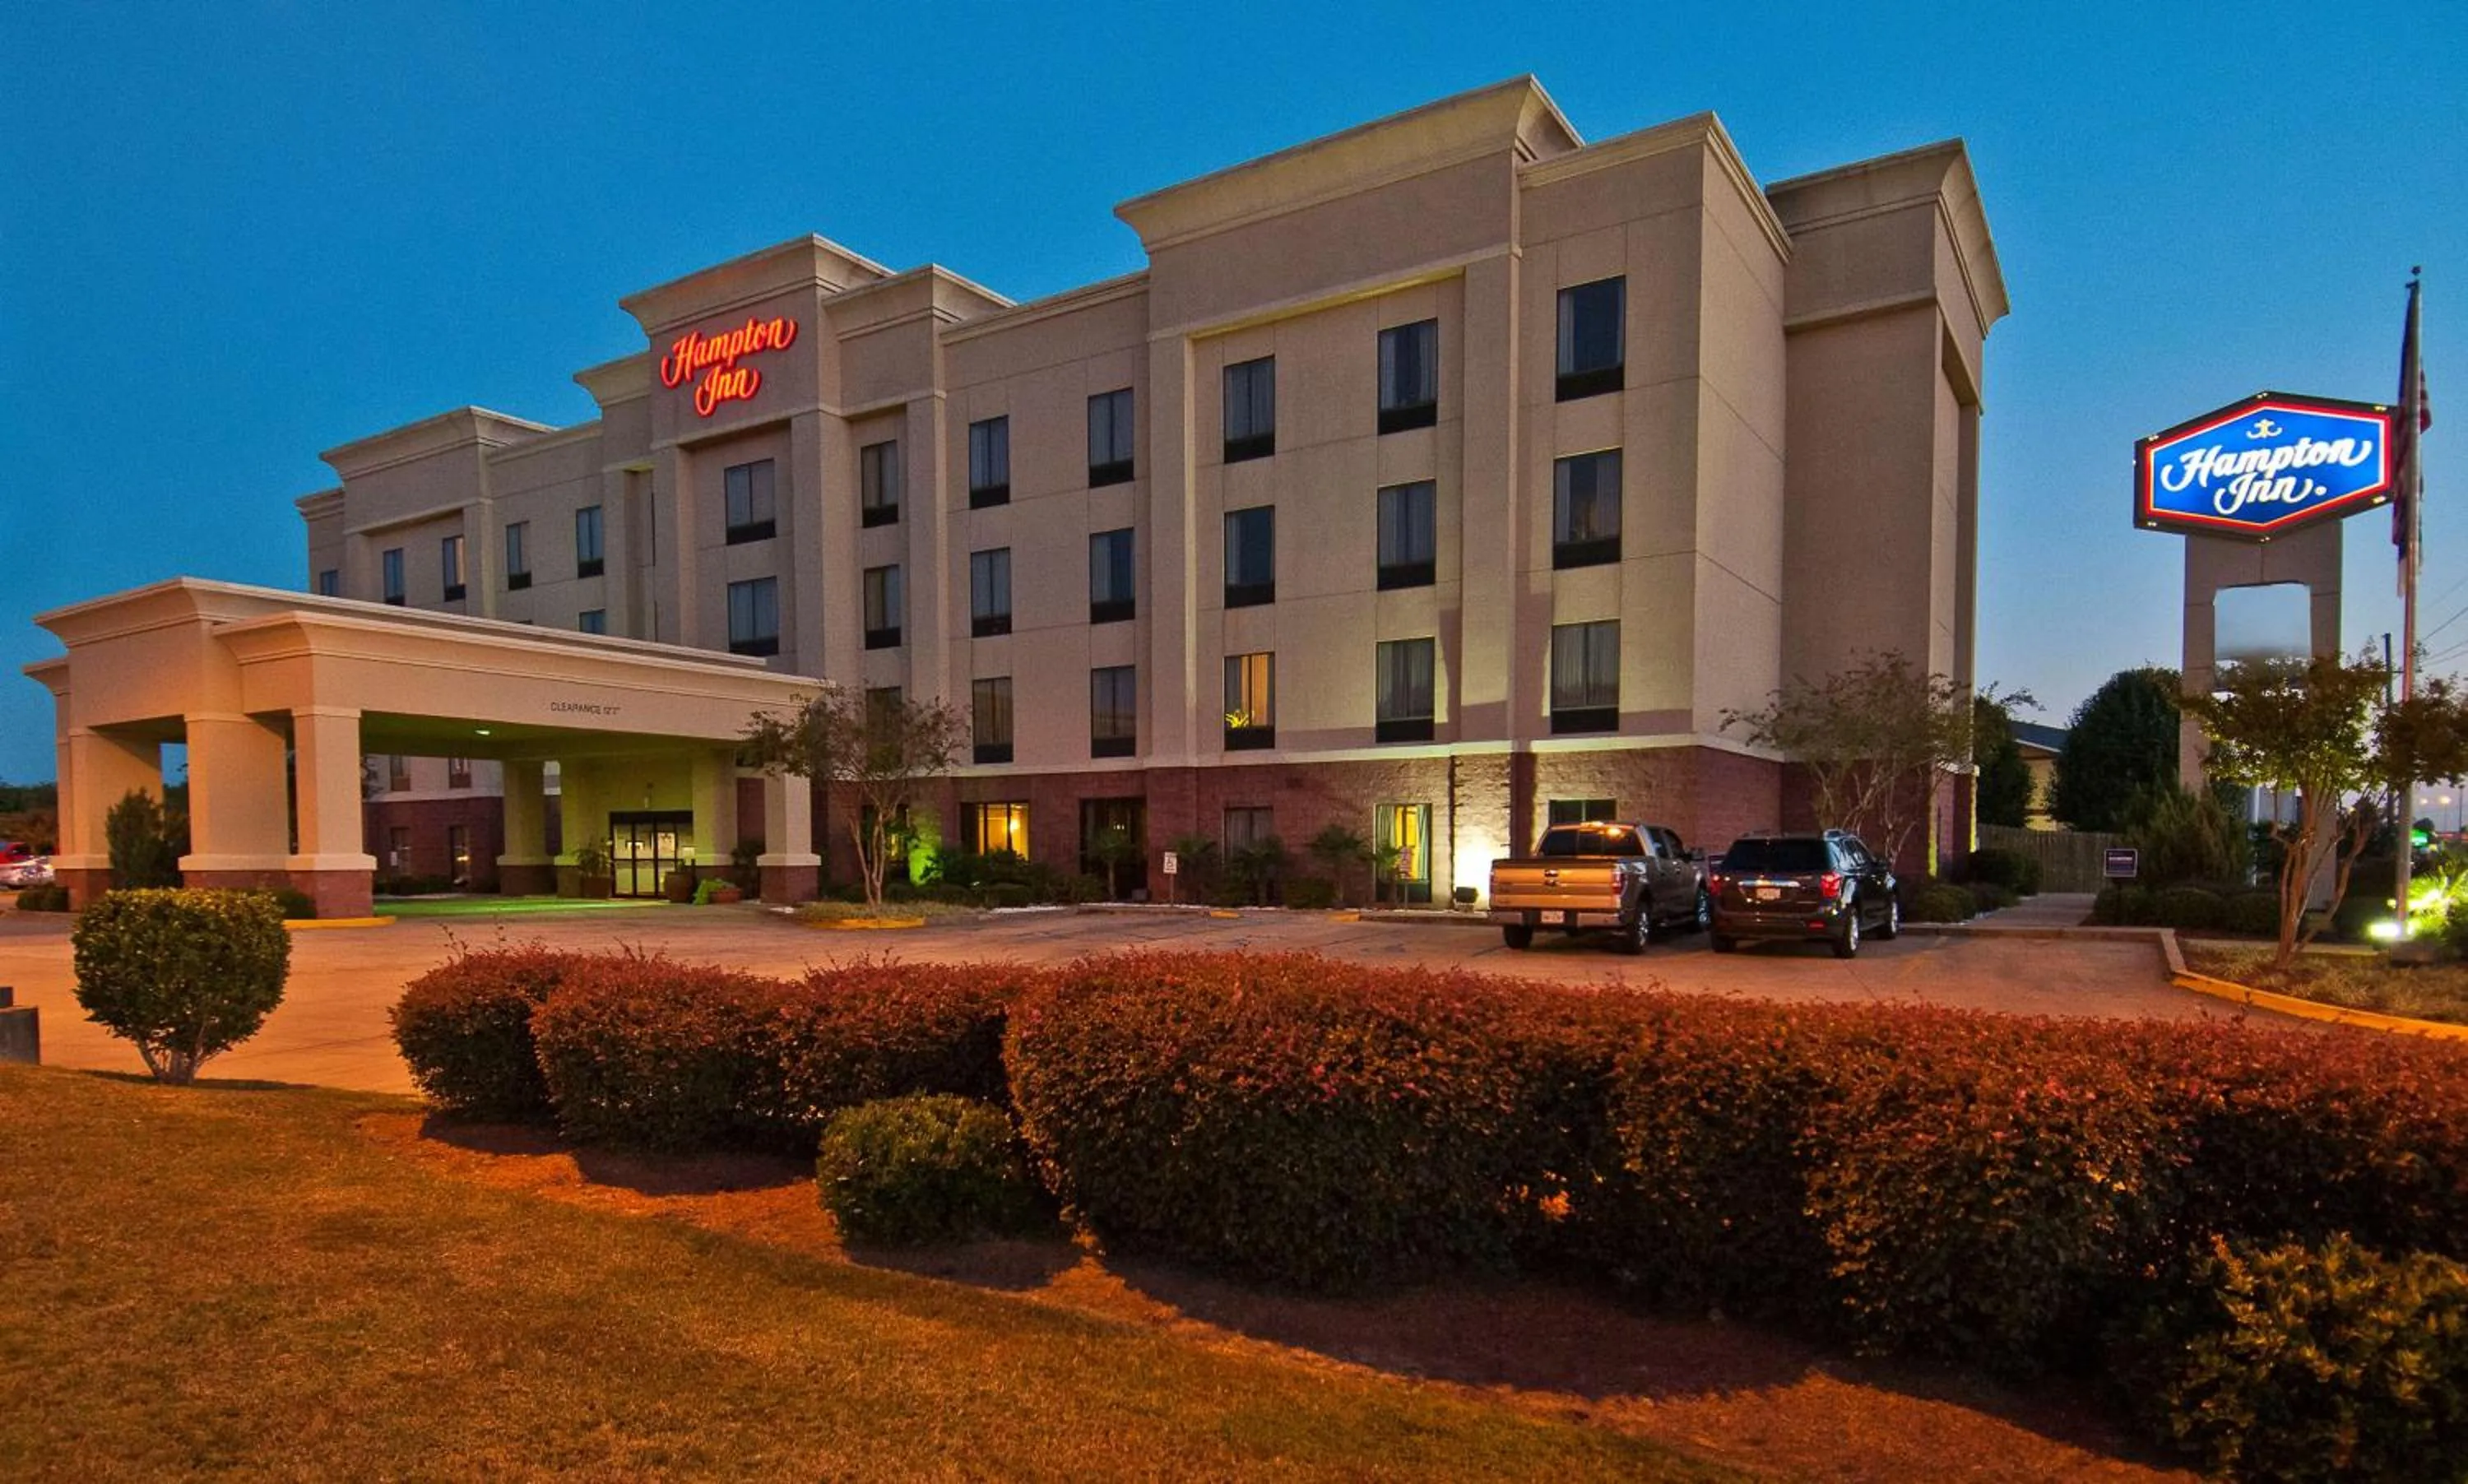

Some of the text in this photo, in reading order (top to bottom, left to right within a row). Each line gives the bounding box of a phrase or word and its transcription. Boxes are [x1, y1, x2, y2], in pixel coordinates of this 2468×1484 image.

[661, 317, 798, 387] Hampton
[695, 365, 762, 417] Inn
[2160, 437, 2373, 492] Hampton
[550, 702, 601, 714] CLEARANCE
